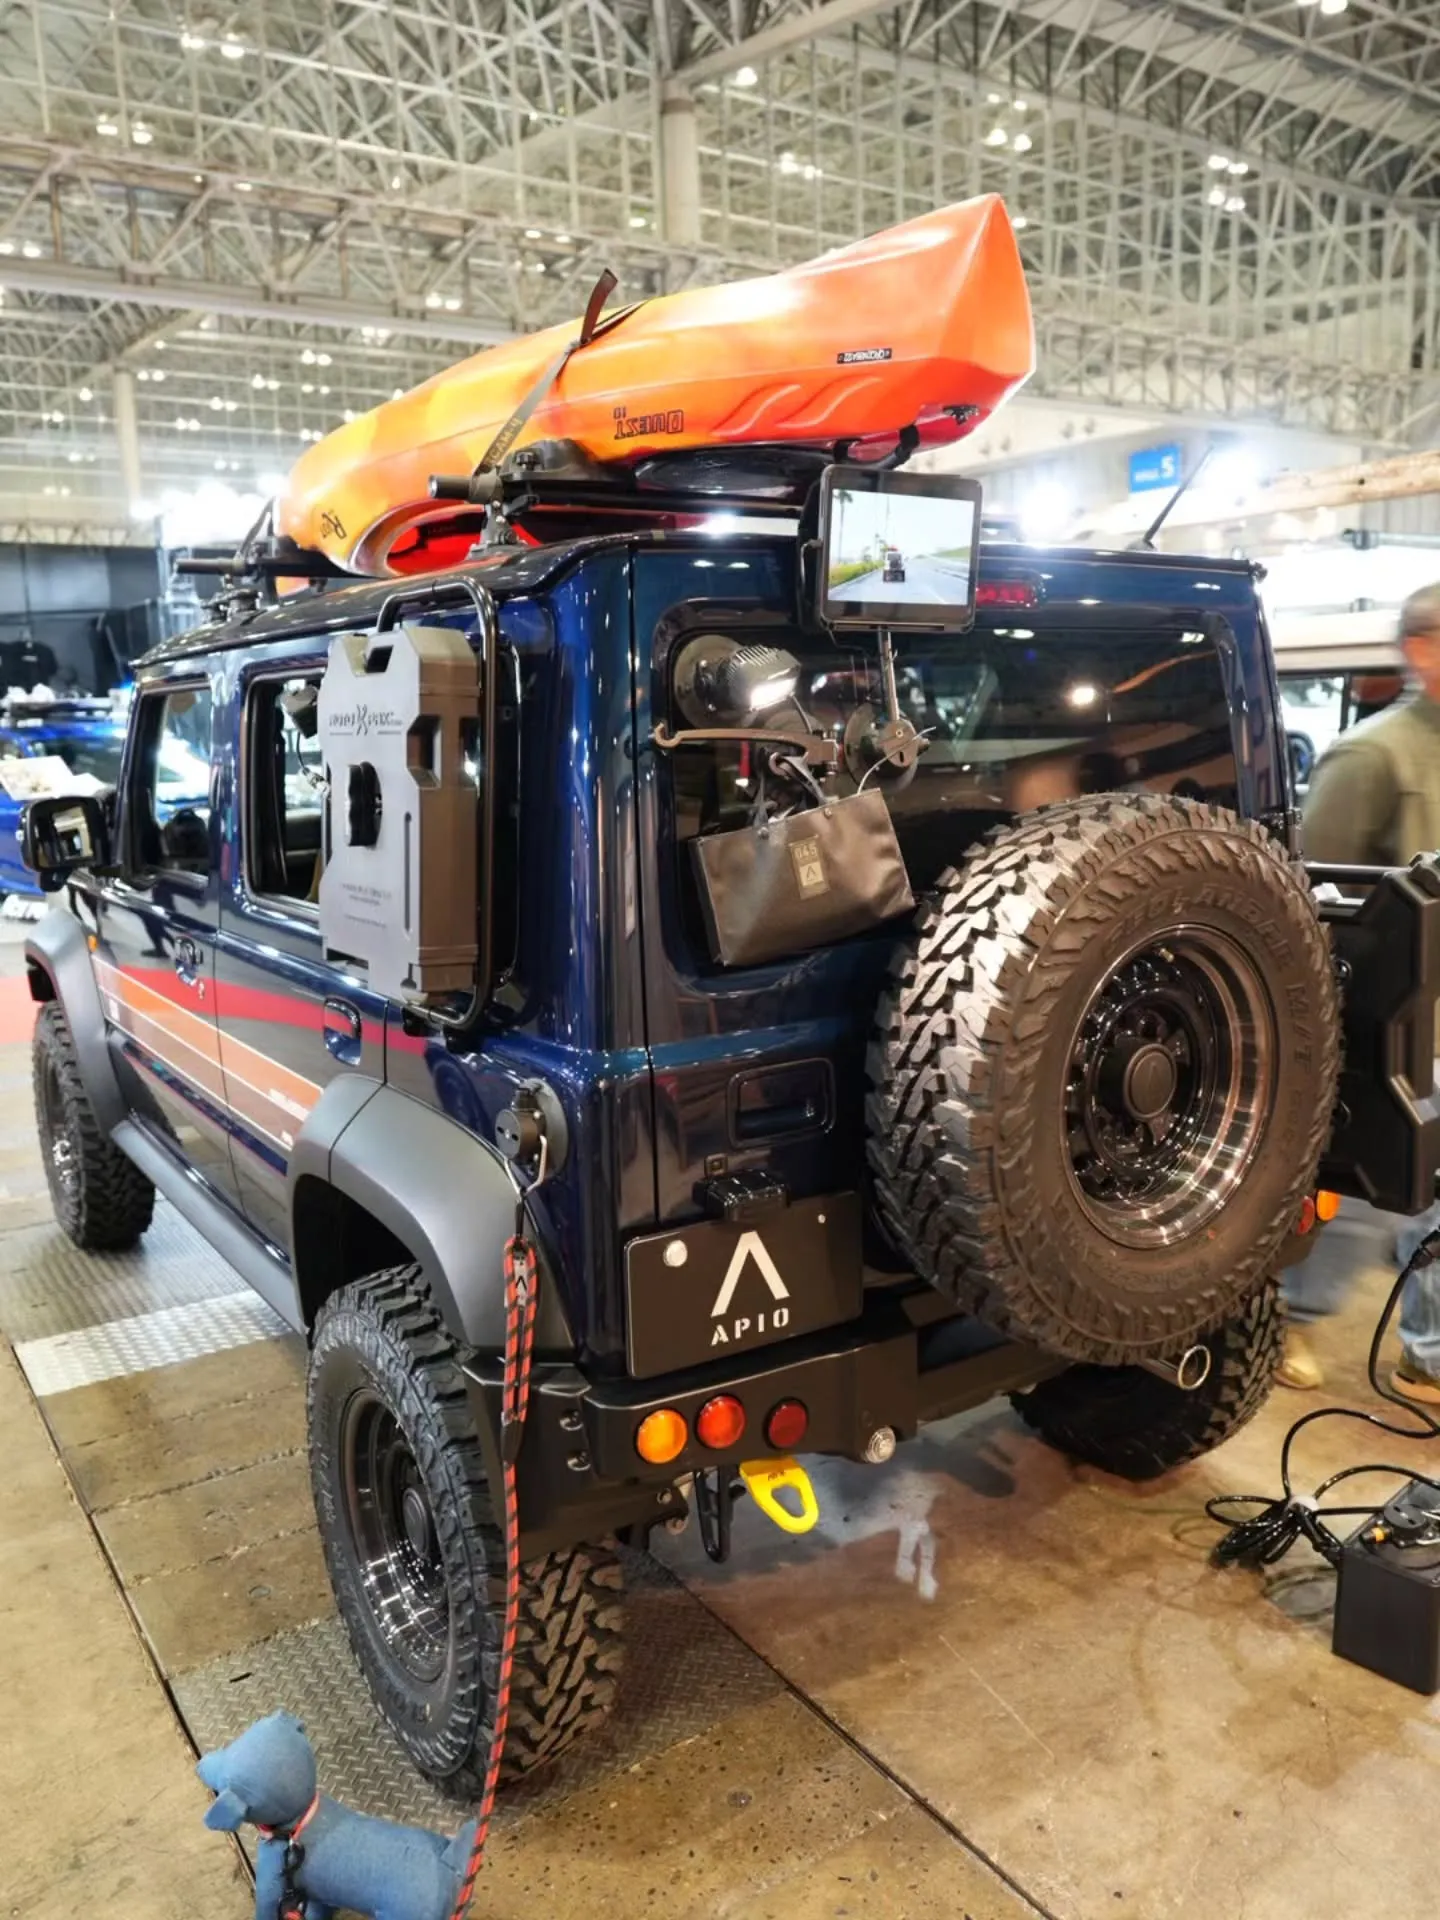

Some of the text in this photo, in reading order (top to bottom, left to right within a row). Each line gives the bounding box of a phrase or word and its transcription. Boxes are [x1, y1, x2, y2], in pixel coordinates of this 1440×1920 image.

[614, 409, 684, 440] QUEST
[1160, 455, 1174, 479] 5
[710, 1307, 790, 1347] APIO
